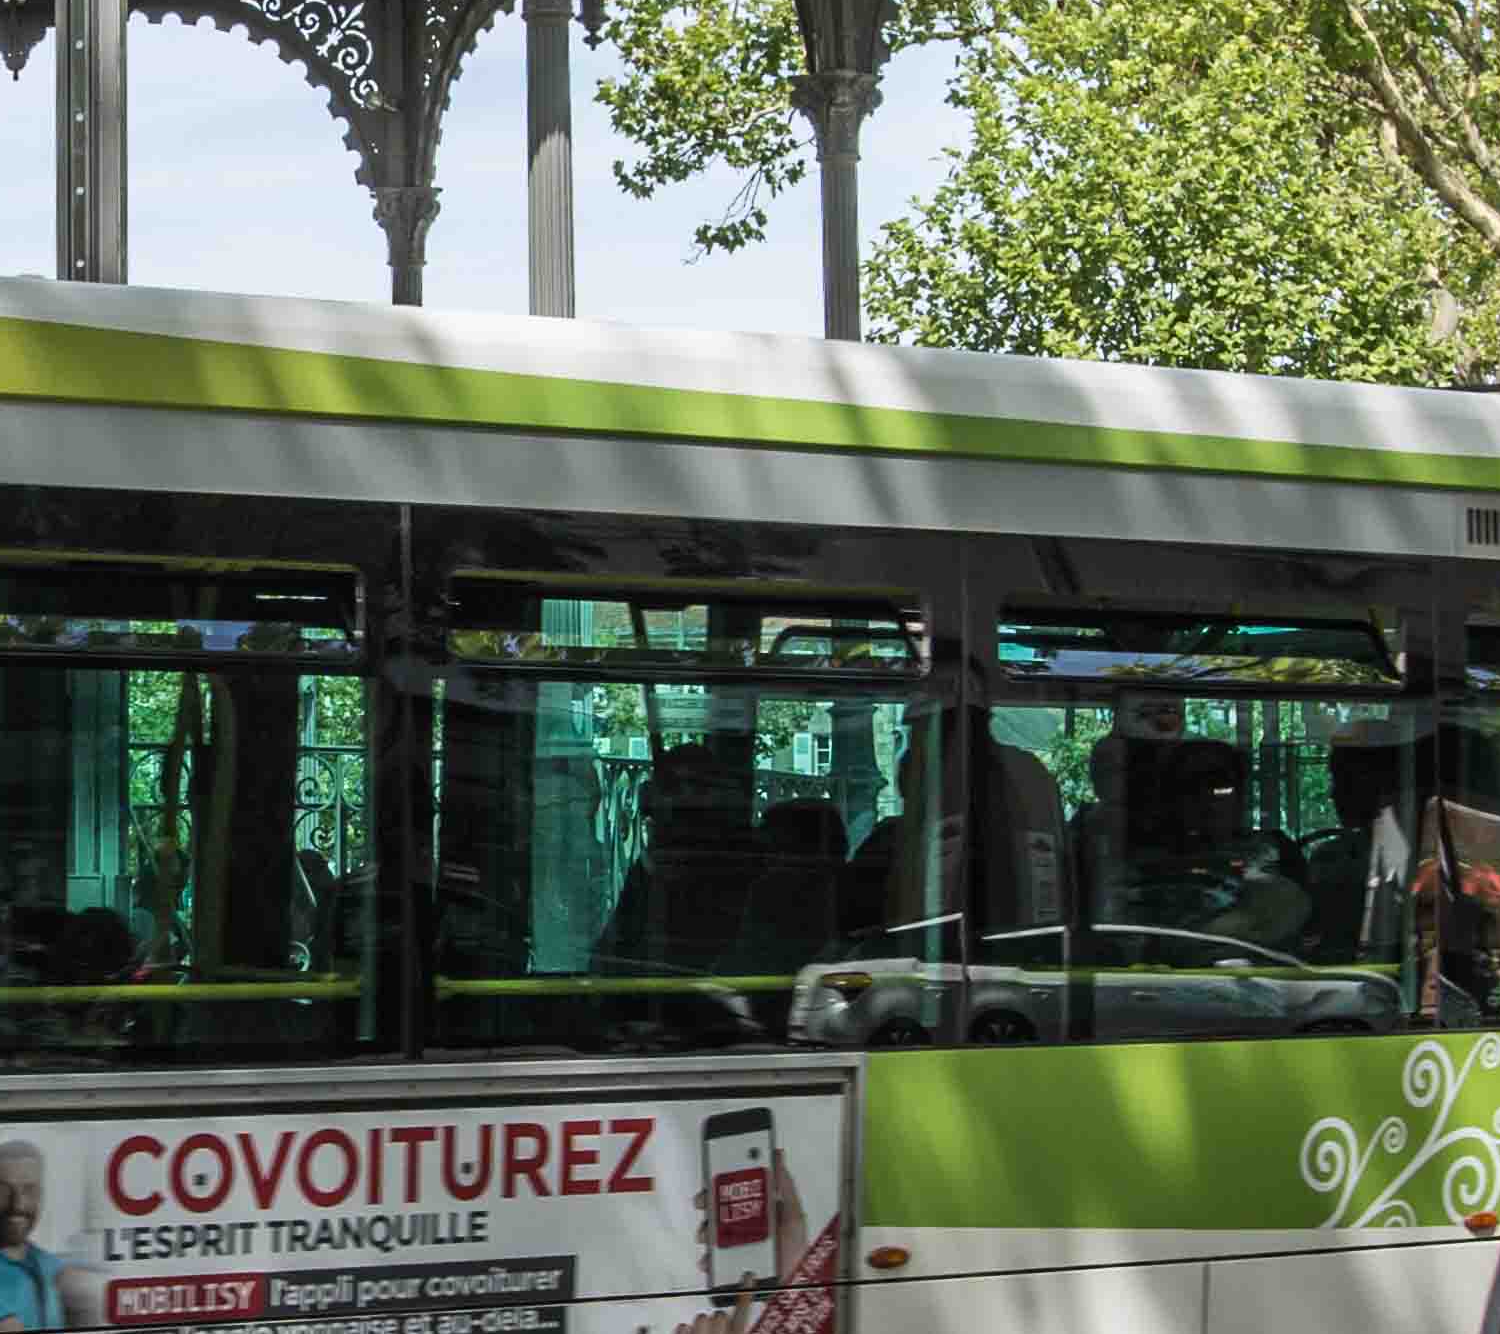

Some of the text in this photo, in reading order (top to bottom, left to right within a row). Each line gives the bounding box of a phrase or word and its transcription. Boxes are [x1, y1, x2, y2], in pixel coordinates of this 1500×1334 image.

[106, 1118, 656, 1216] COVOITUREZ
[104, 1211, 489, 1262] L'ESPRIT TRANQUILLE
[116, 1281, 257, 1317] MOBILISY
[269, 1275, 353, 1312] l'appli
[357, 1278, 420, 1308] pour
